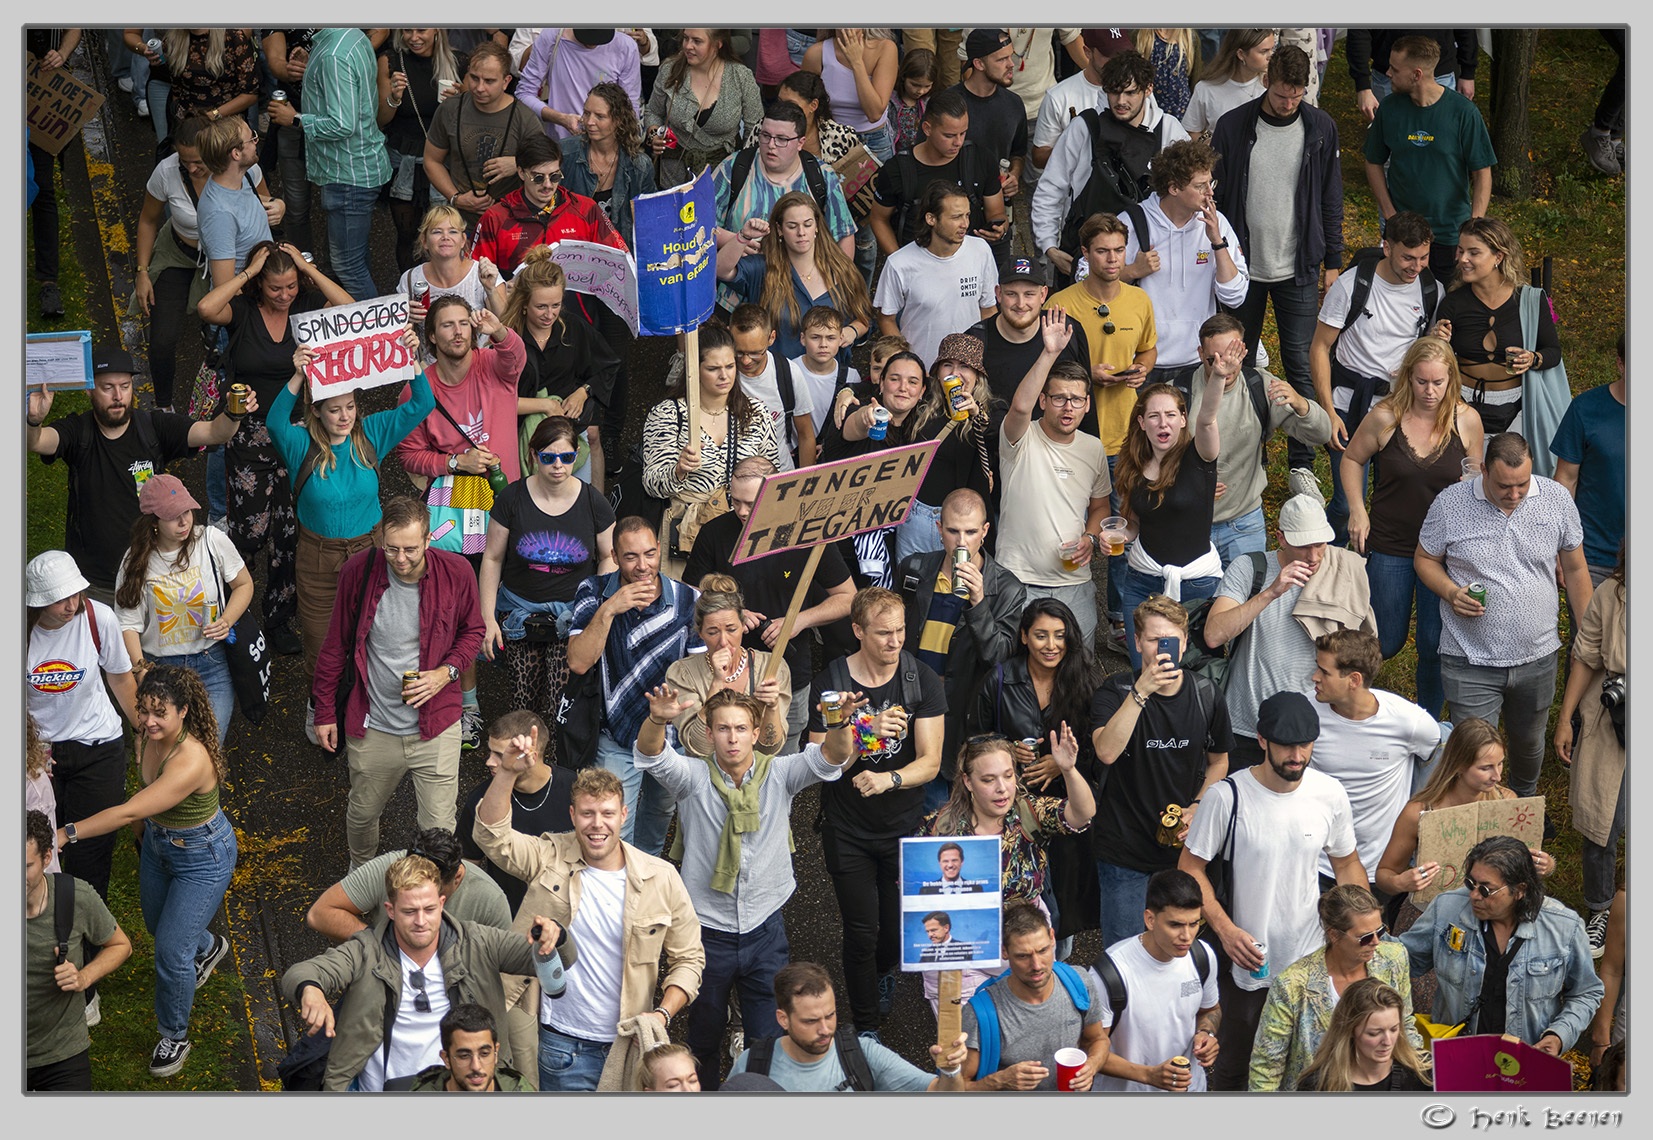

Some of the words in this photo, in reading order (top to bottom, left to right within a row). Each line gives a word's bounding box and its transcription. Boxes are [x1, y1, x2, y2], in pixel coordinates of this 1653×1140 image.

[663, 237, 697, 255] Houd
[591, 255, 626, 281] mag
[567, 273, 595, 286] wel
[659, 273, 683, 286] van
[776, 452, 926, 501] TONGEN
[747, 495, 912, 557] TOEGANG
[30, 672, 81, 685] Dickies
[1441, 819, 1467, 846] Why
